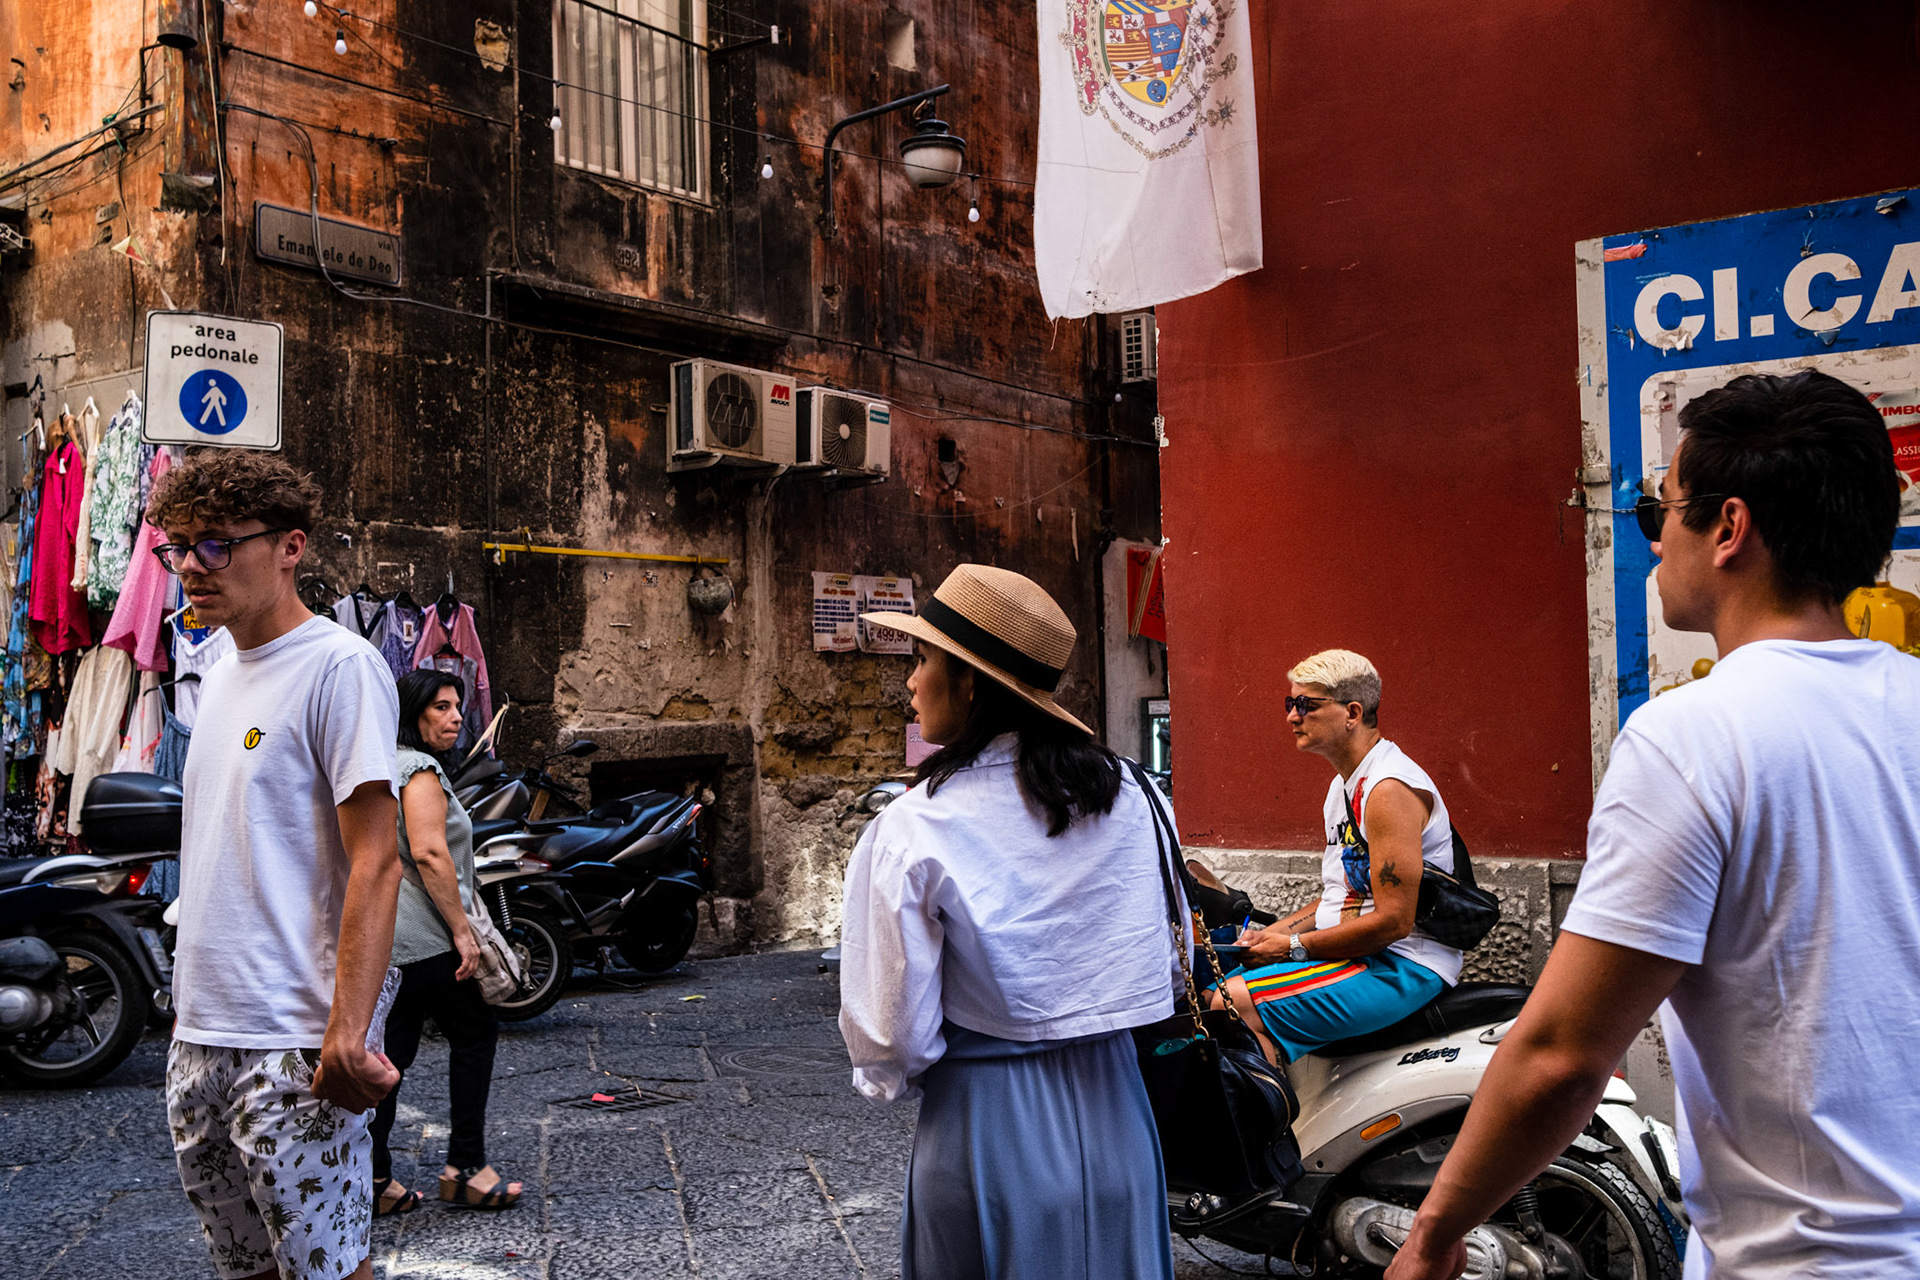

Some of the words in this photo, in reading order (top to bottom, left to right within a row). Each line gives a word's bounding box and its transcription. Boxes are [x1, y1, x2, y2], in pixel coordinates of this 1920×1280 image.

[378, 241, 391, 251] via
[278, 234, 343, 264] Emanele
[349, 251, 363, 268] de
[369, 255, 392, 275] Deo
[195, 325, 236, 341] area
[170, 343, 259, 364] pedonale
[1876, 405, 1920, 417] IMB
[1893, 445, 1920, 456] ASSI
